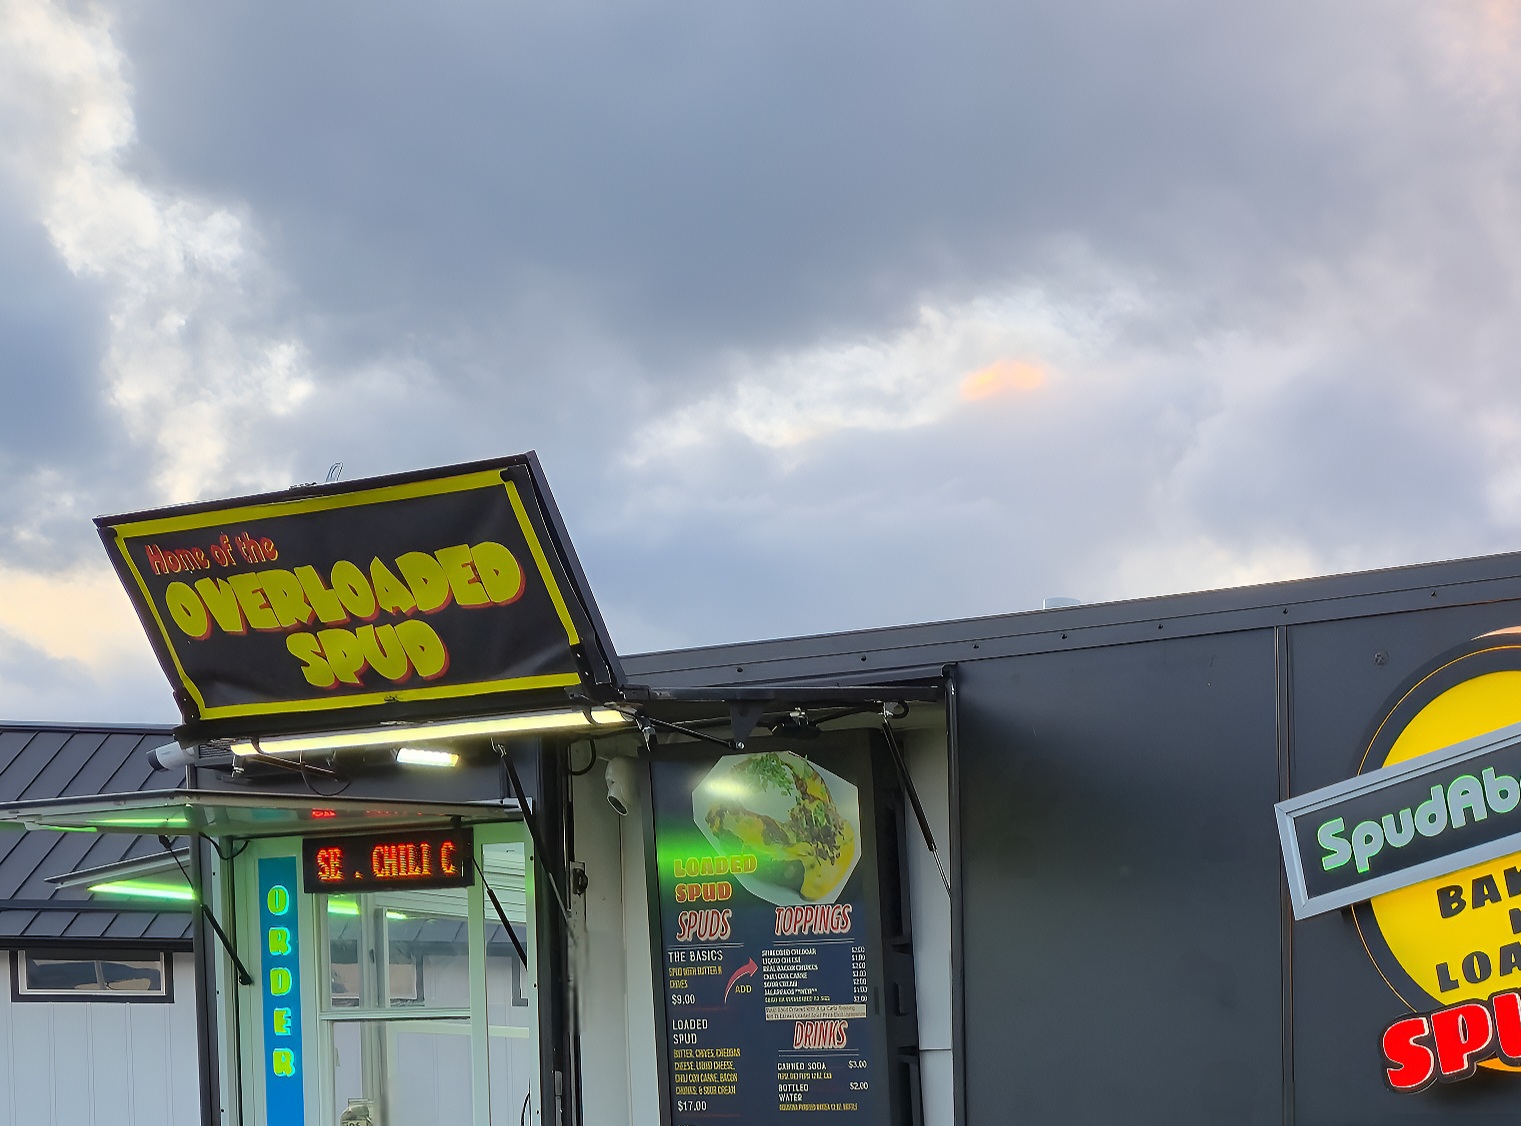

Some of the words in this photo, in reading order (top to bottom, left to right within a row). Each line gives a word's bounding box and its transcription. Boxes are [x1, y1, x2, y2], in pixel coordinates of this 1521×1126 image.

[146, 543, 211, 575] Home
[213, 533, 238, 567] of
[238, 531, 279, 563] the
[165, 541, 526, 641] OVERLOADED
[286, 619, 450, 689] SPUD
[371, 842, 432, 879] CHILI
[440, 840, 458, 876] C
[674, 854, 757, 878] LOADED
[675, 881, 732, 902] SPUD
[676, 908, 732, 942] SPUDS
[774, 904, 852, 936] TOPPINGS
[668, 951, 686, 963] THE
[689, 950, 723, 962] BASICS
[266, 884, 296, 1078] ORDER
[735, 984, 752, 993] ADD
[671, 994, 695, 1005] $9.00
[672, 1019, 708, 1030] LOADED
[793, 1020, 848, 1049] DRINKS
[673, 1033, 698, 1044] SPUD
[777, 1062, 805, 1071] CANNED
[807, 1062, 827, 1070] SODA
[778, 1083, 809, 1092] BOTTLED
[778, 1093, 803, 1102] WATER
[677, 1100, 707, 1112] $17.00
